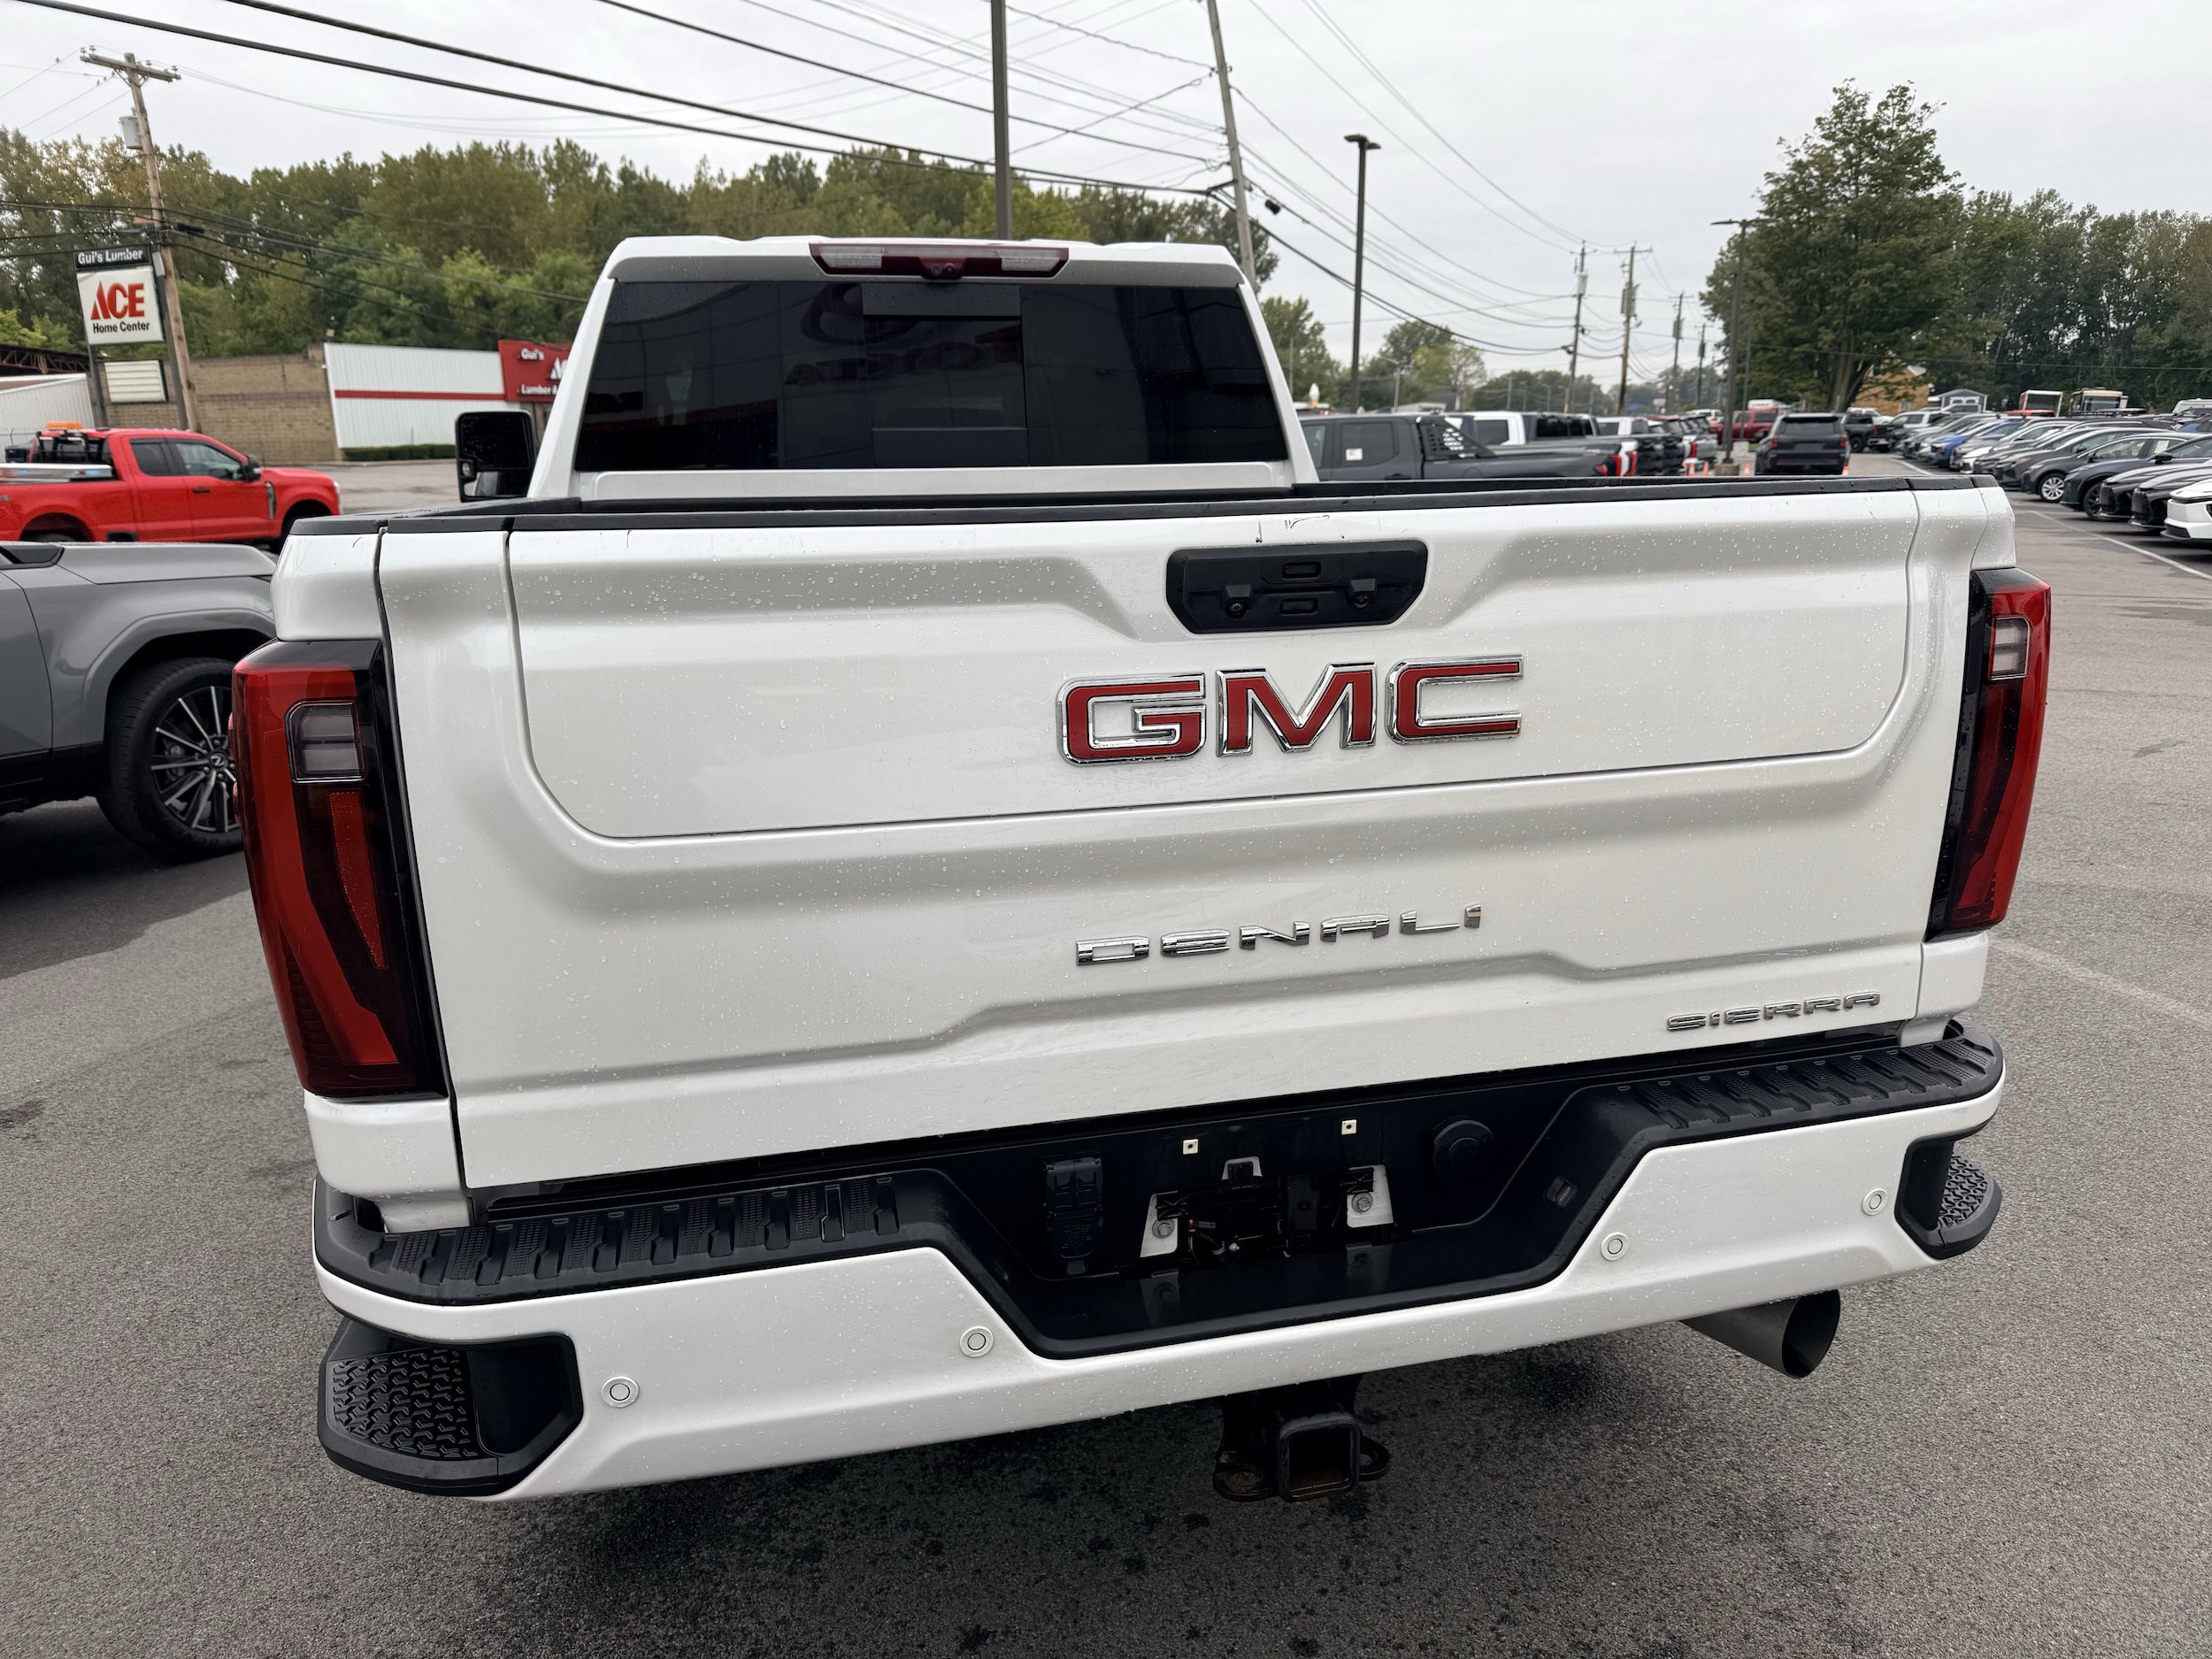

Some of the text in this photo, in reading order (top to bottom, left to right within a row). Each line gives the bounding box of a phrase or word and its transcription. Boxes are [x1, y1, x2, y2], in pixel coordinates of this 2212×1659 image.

[78, 249, 143, 265] Gui's Lumber
[91, 280, 144, 319] ACE
[93, 320, 150, 334] Home Center
[521, 384, 550, 395] Lumber
[1058, 655, 1523, 765] GMC
[1076, 903, 1482, 966] DENALI
[1667, 991, 1881, 1032] SIERRA
